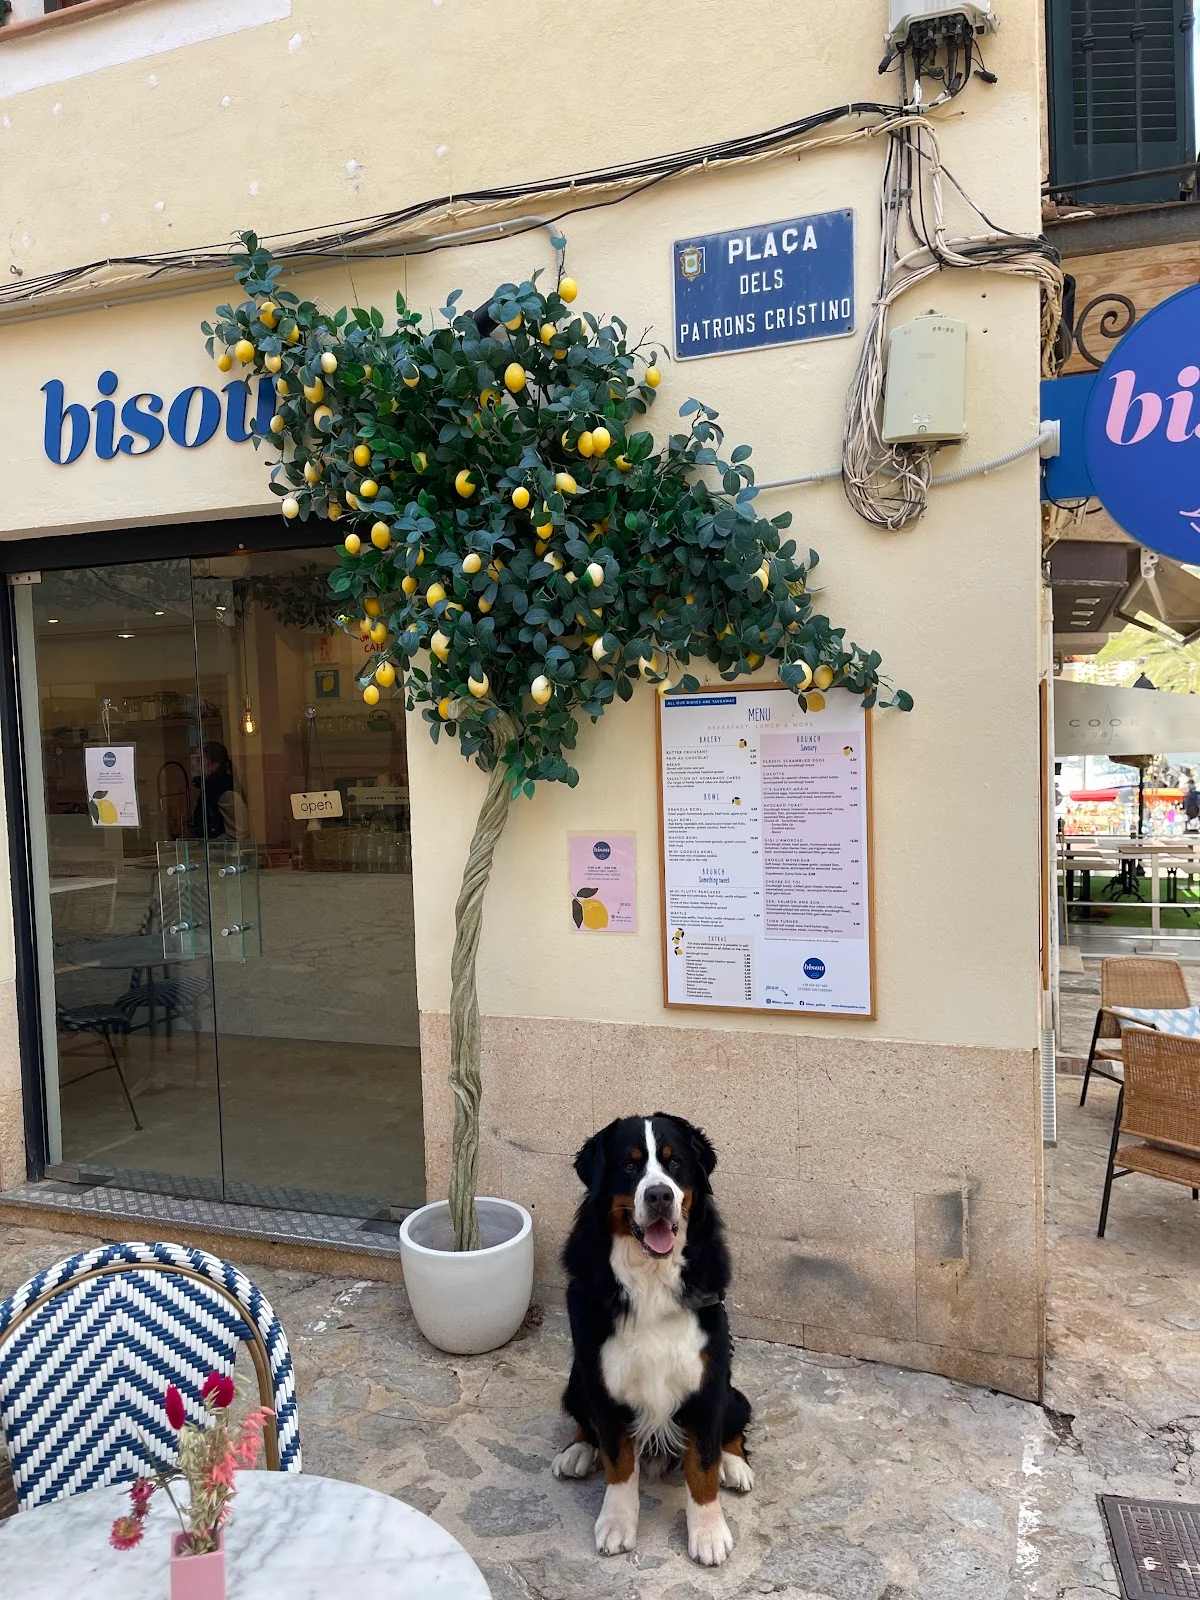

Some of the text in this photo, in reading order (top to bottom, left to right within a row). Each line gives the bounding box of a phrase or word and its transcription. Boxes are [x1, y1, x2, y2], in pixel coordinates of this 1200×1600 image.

[728, 225, 818, 264] PLAÇA
[740, 269, 783, 295] DELS
[680, 298, 850, 343] PATRONS CRISTINO
[1106, 366, 1200, 445] bi
[748, 708, 770, 721] MENU
[801, 744, 817, 753] Savoury
[301, 801, 332, 813] open
